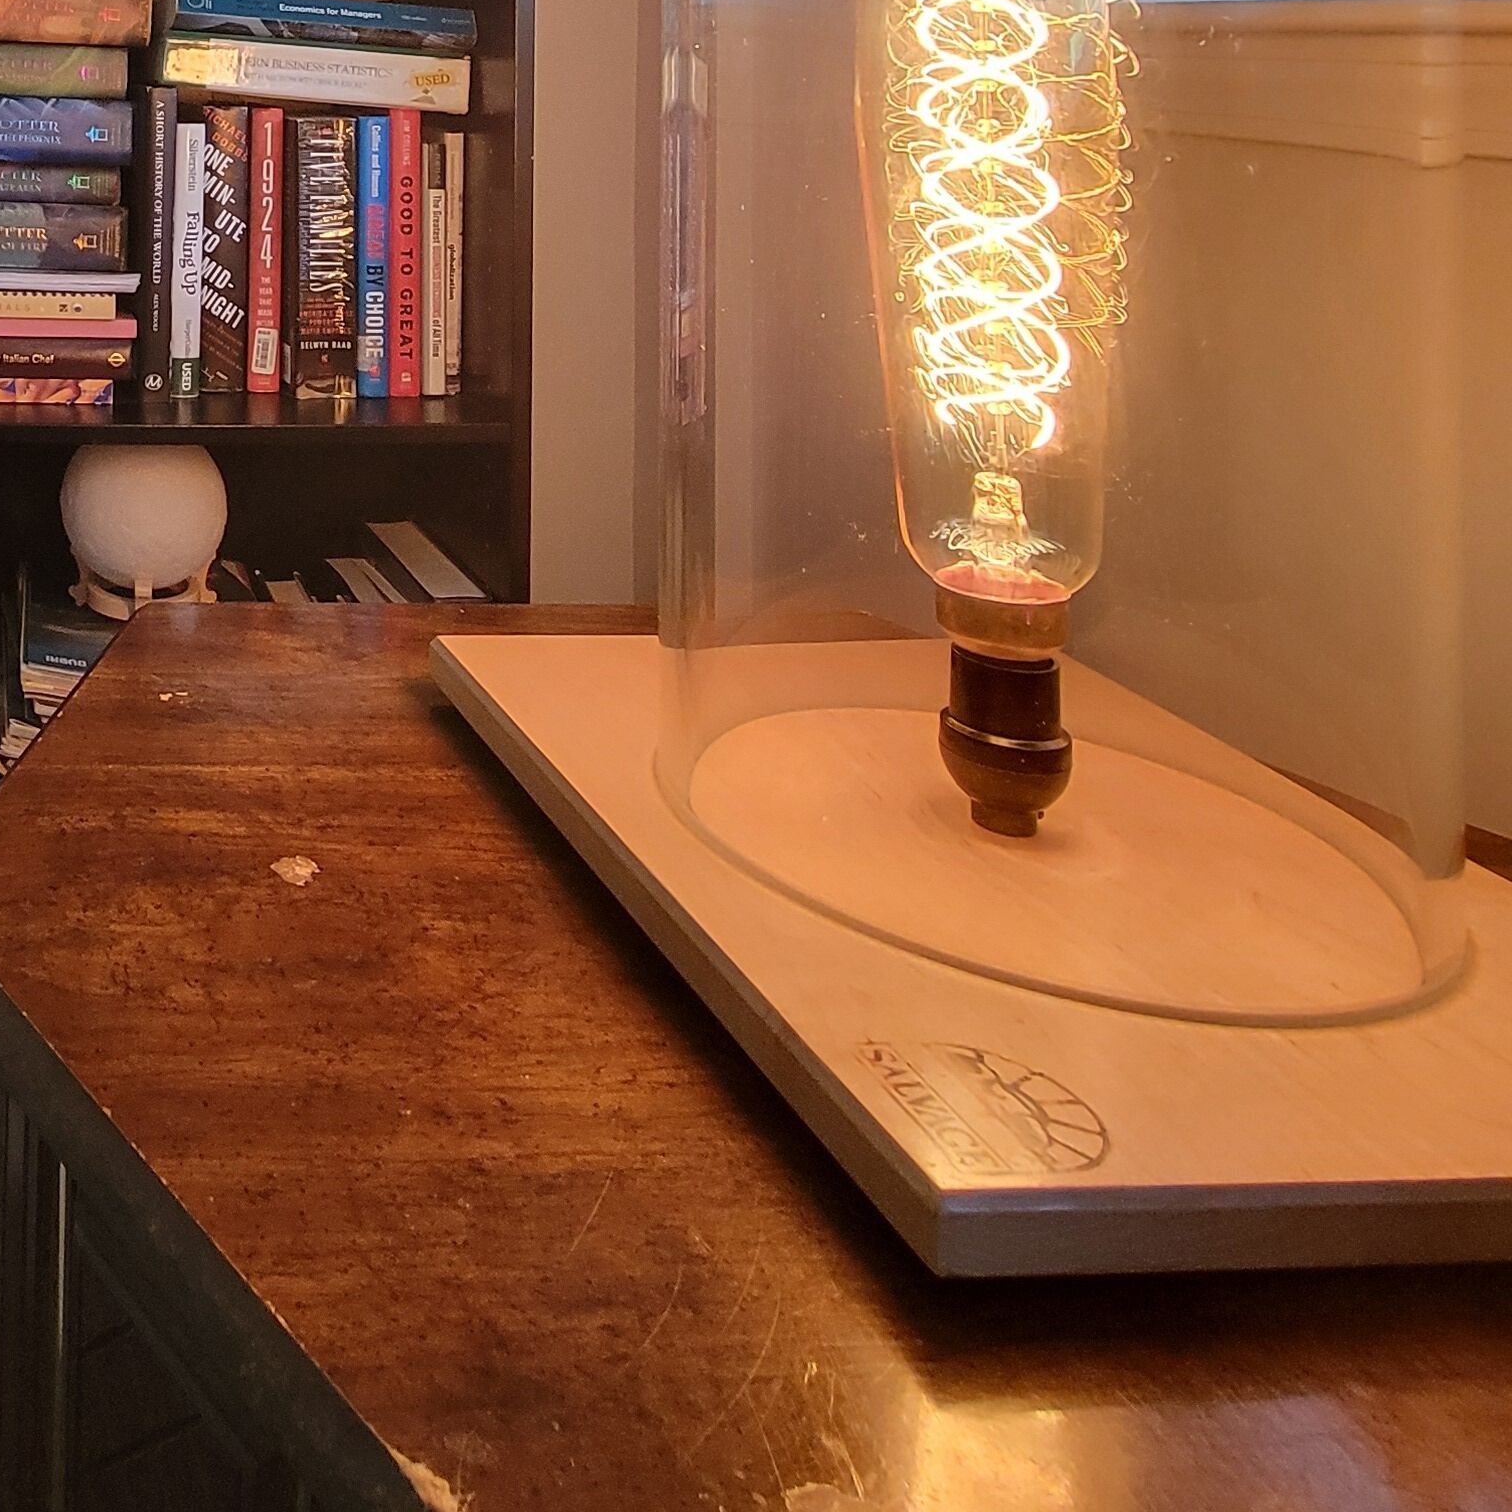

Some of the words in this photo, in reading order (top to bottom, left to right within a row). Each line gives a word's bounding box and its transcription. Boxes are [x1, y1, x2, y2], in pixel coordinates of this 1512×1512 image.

[279, 3, 325, 16] Economics
[326, 6, 339, 17] for
[340, 8, 382, 20] Managers
[272, 59, 326, 72] BUSINESS
[327, 63, 393, 78] STATISTICS
[415, 73, 450, 88] USED
[155, 100, 164, 109] A
[18, 134, 62, 144] PHOENIX
[155, 110, 165, 149] SHORT
[371, 124, 381, 151] Collins
[187, 138, 199, 192] Silverstein
[203, 143, 234, 177] ONE
[310, 137, 345, 186] FIVE
[371, 154, 381, 168] and
[154, 151, 165, 199] HISTORY
[153, 199, 163, 215] OF
[259, 121, 275, 269] 1924
[400, 175, 413, 236] GOOD
[433, 195, 442, 208] The
[153, 216, 163, 240] THE
[180, 211, 200, 268] Falling
[201, 226, 220, 255] TO
[214, 212, 247, 243] UTE
[432, 210, 442, 244] Greatest
[310, 194, 346, 293] FAMILIES
[152, 240, 163, 284] WORLD
[201, 256, 235, 290] MID-
[367, 265, 384, 286] BY
[400, 248, 413, 276] TO
[448, 243, 457, 301] globalization
[180, 270, 199, 296] Up
[201, 288, 245, 330] NIGHT
[365, 290, 385, 358] CHOICE
[399, 288, 413, 360] GREAT
[2, 352, 30, 364] Italian
[32, 352, 54, 364] Chef
[300, 341, 330, 350] SELWYN
[331, 341, 352, 350] RAAB
[432, 338, 441, 358] Time
[181, 362, 192, 391] USED
